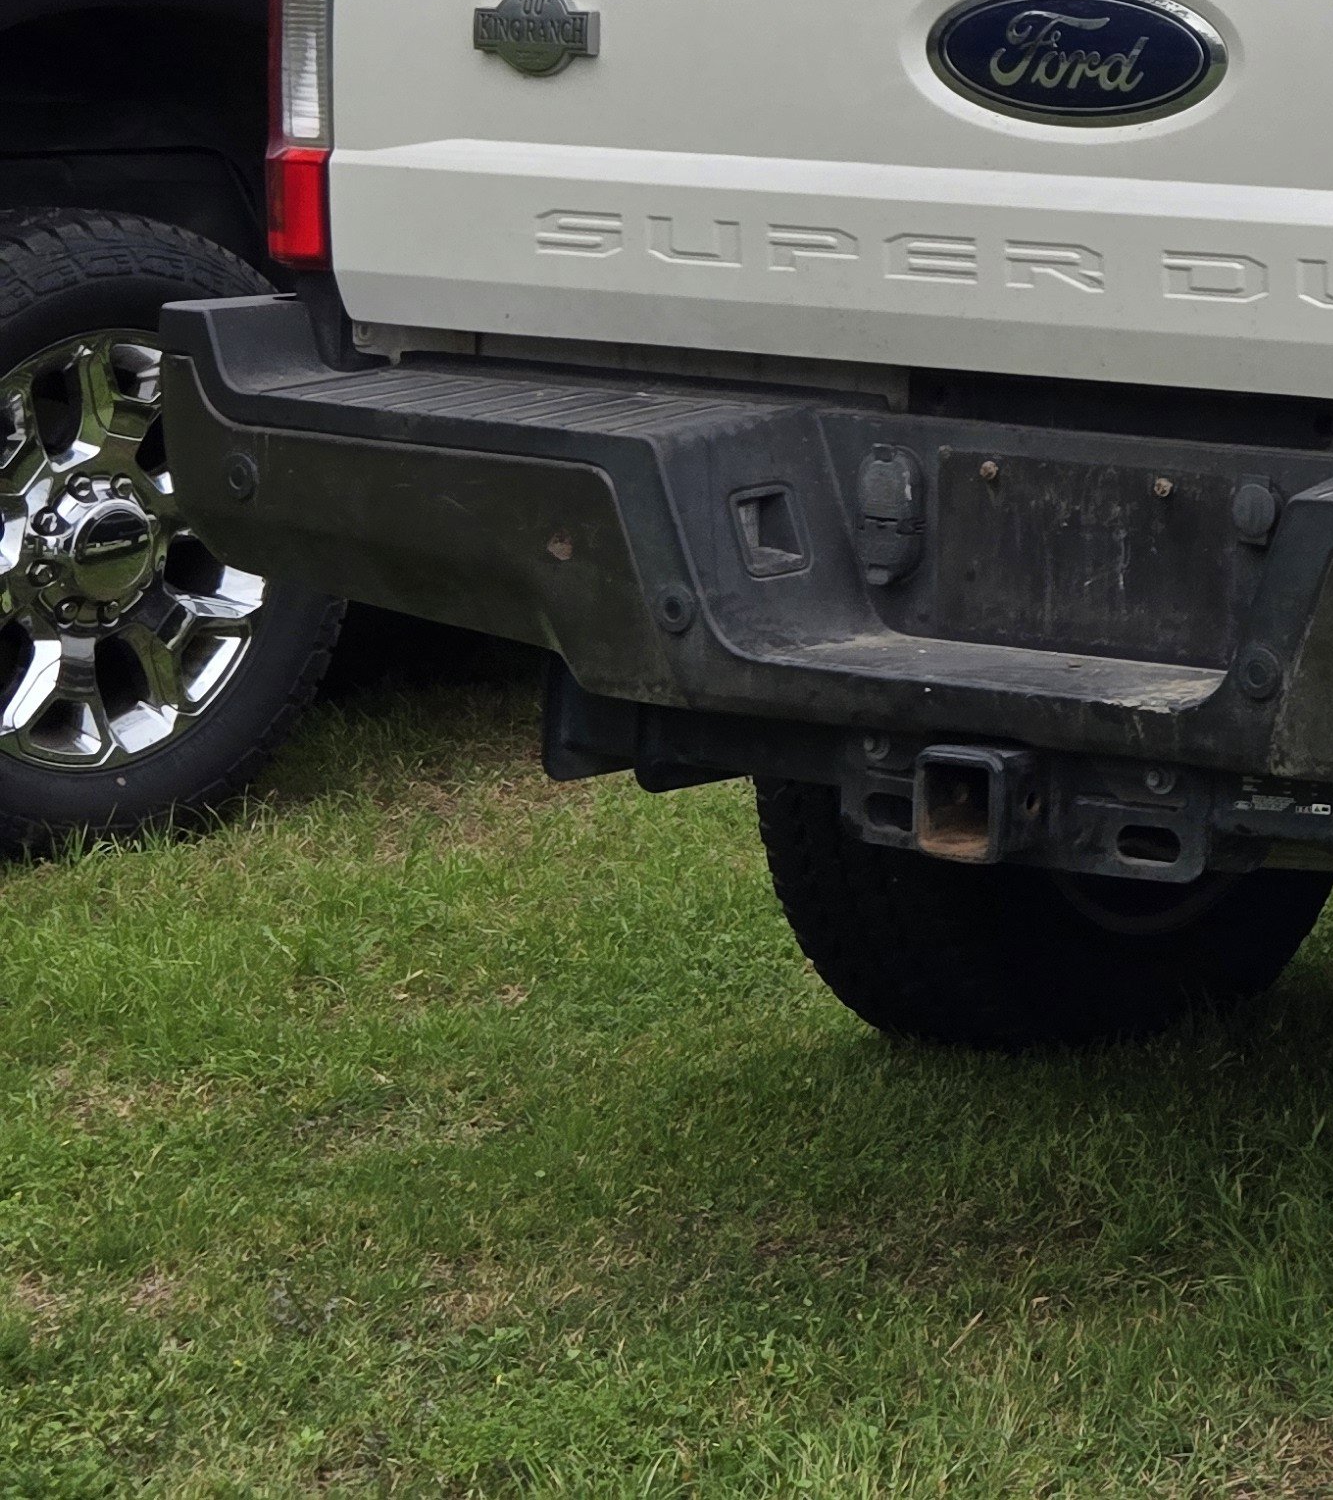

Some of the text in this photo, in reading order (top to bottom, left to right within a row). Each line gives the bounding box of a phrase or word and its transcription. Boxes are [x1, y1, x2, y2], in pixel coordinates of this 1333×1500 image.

[480, 13, 584, 45] KING RANCH
[990, 10, 1149, 92] Ford
[535, 209, 1105, 293] SUPER
